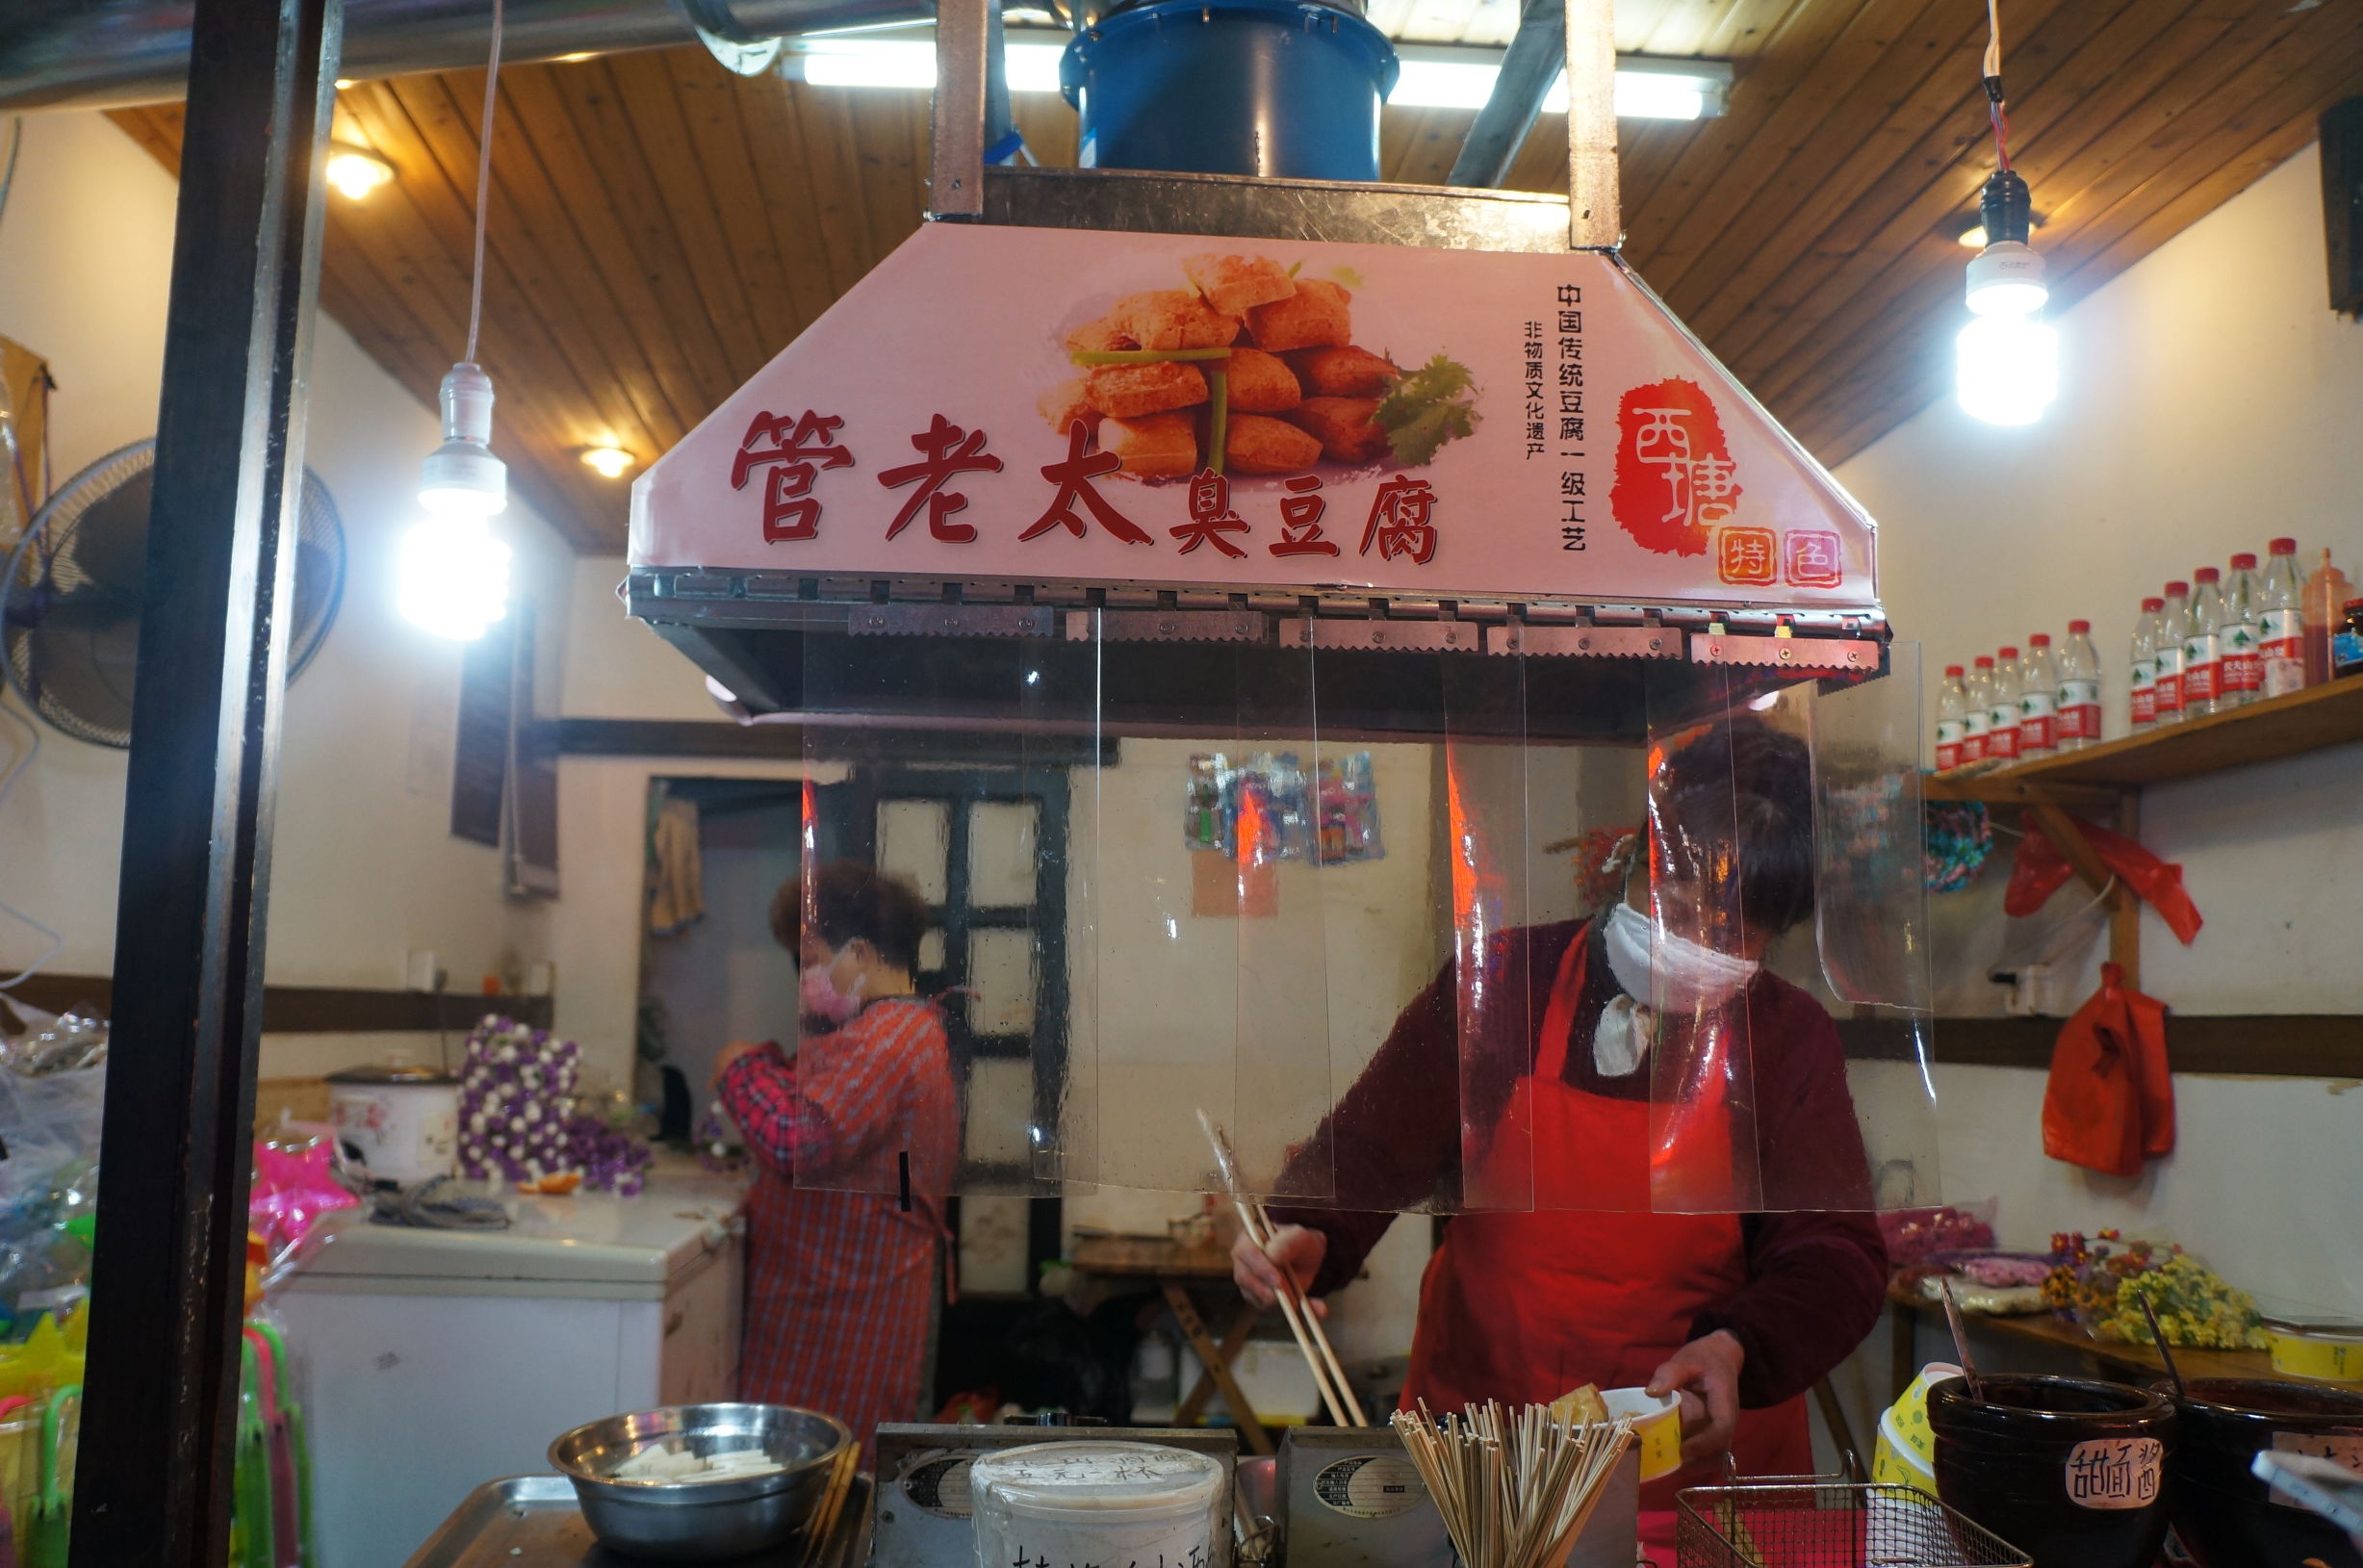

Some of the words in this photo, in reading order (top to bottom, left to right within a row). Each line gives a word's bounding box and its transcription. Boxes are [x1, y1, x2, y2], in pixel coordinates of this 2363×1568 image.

[1524, 320, 1546, 461] 非物质文化遗产
[1556, 284, 1586, 553] 中国传统豆腐一级工艺
[731, 409, 1438, 565] 管老太臭豆腐
[1631, 407, 1736, 528] 西塘
